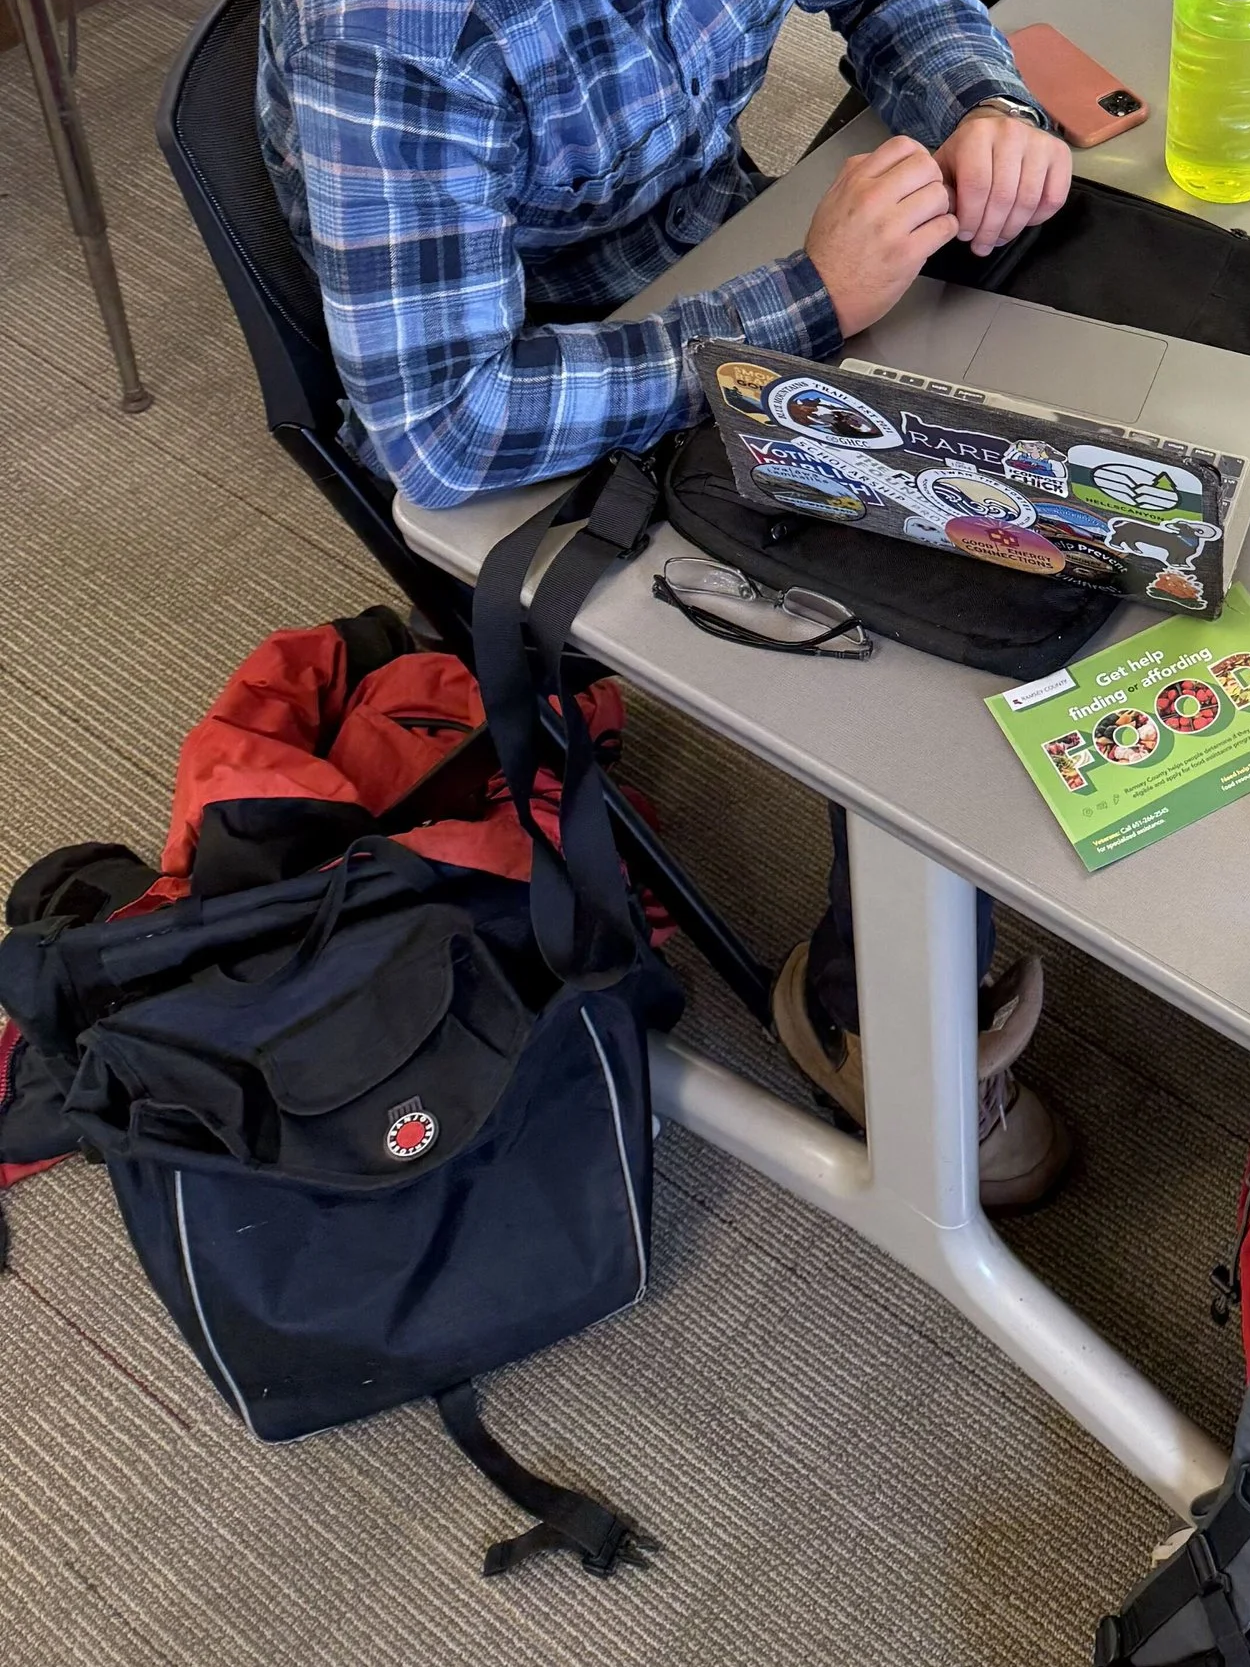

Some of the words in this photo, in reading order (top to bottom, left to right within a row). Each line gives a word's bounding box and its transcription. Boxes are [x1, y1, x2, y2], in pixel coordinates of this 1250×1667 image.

[812, 382, 849, 400] TRAIL
[909, 430, 1002, 465] RARE
[799, 441, 906, 502] SCHOLARSHIP
[1012, 475, 1063, 494] CHICK
[1084, 497, 1165, 521] HELLSCANYON
[961, 538, 994, 549] GOOD
[966, 544, 1054, 569] CONNECTIONS
[1007, 548, 1051, 563] ENERGY
[1077, 544, 1128, 573] Prevent
[1096, 666, 1128, 687] Get
[1128, 649, 1166, 674] help
[1044, 678, 1068, 693] COUNTY
[1067, 689, 1128, 722] finding
[1128, 683, 1139, 693] or
[1141, 647, 1213, 688] affording
[1146, 768, 1169, 784] County
[1168, 760, 1184, 775] helps
[1184, 752, 1204, 767] people
[1203, 738, 1232, 755] determine
[1236, 727, 1250, 739] they
[1132, 783, 1154, 799] eligible
[1153, 778, 1166, 789] and
[1165, 770, 1183, 785] apply
[1190, 757, 1206, 770] food
[1220, 770, 1238, 784] Need
[1221, 779, 1236, 792] food
[1120, 823, 1133, 835] Call
[1096, 841, 1107, 854] for
[391, 1114, 427, 1137] BANJO
[389, 1124, 434, 1154] BROTHERS
